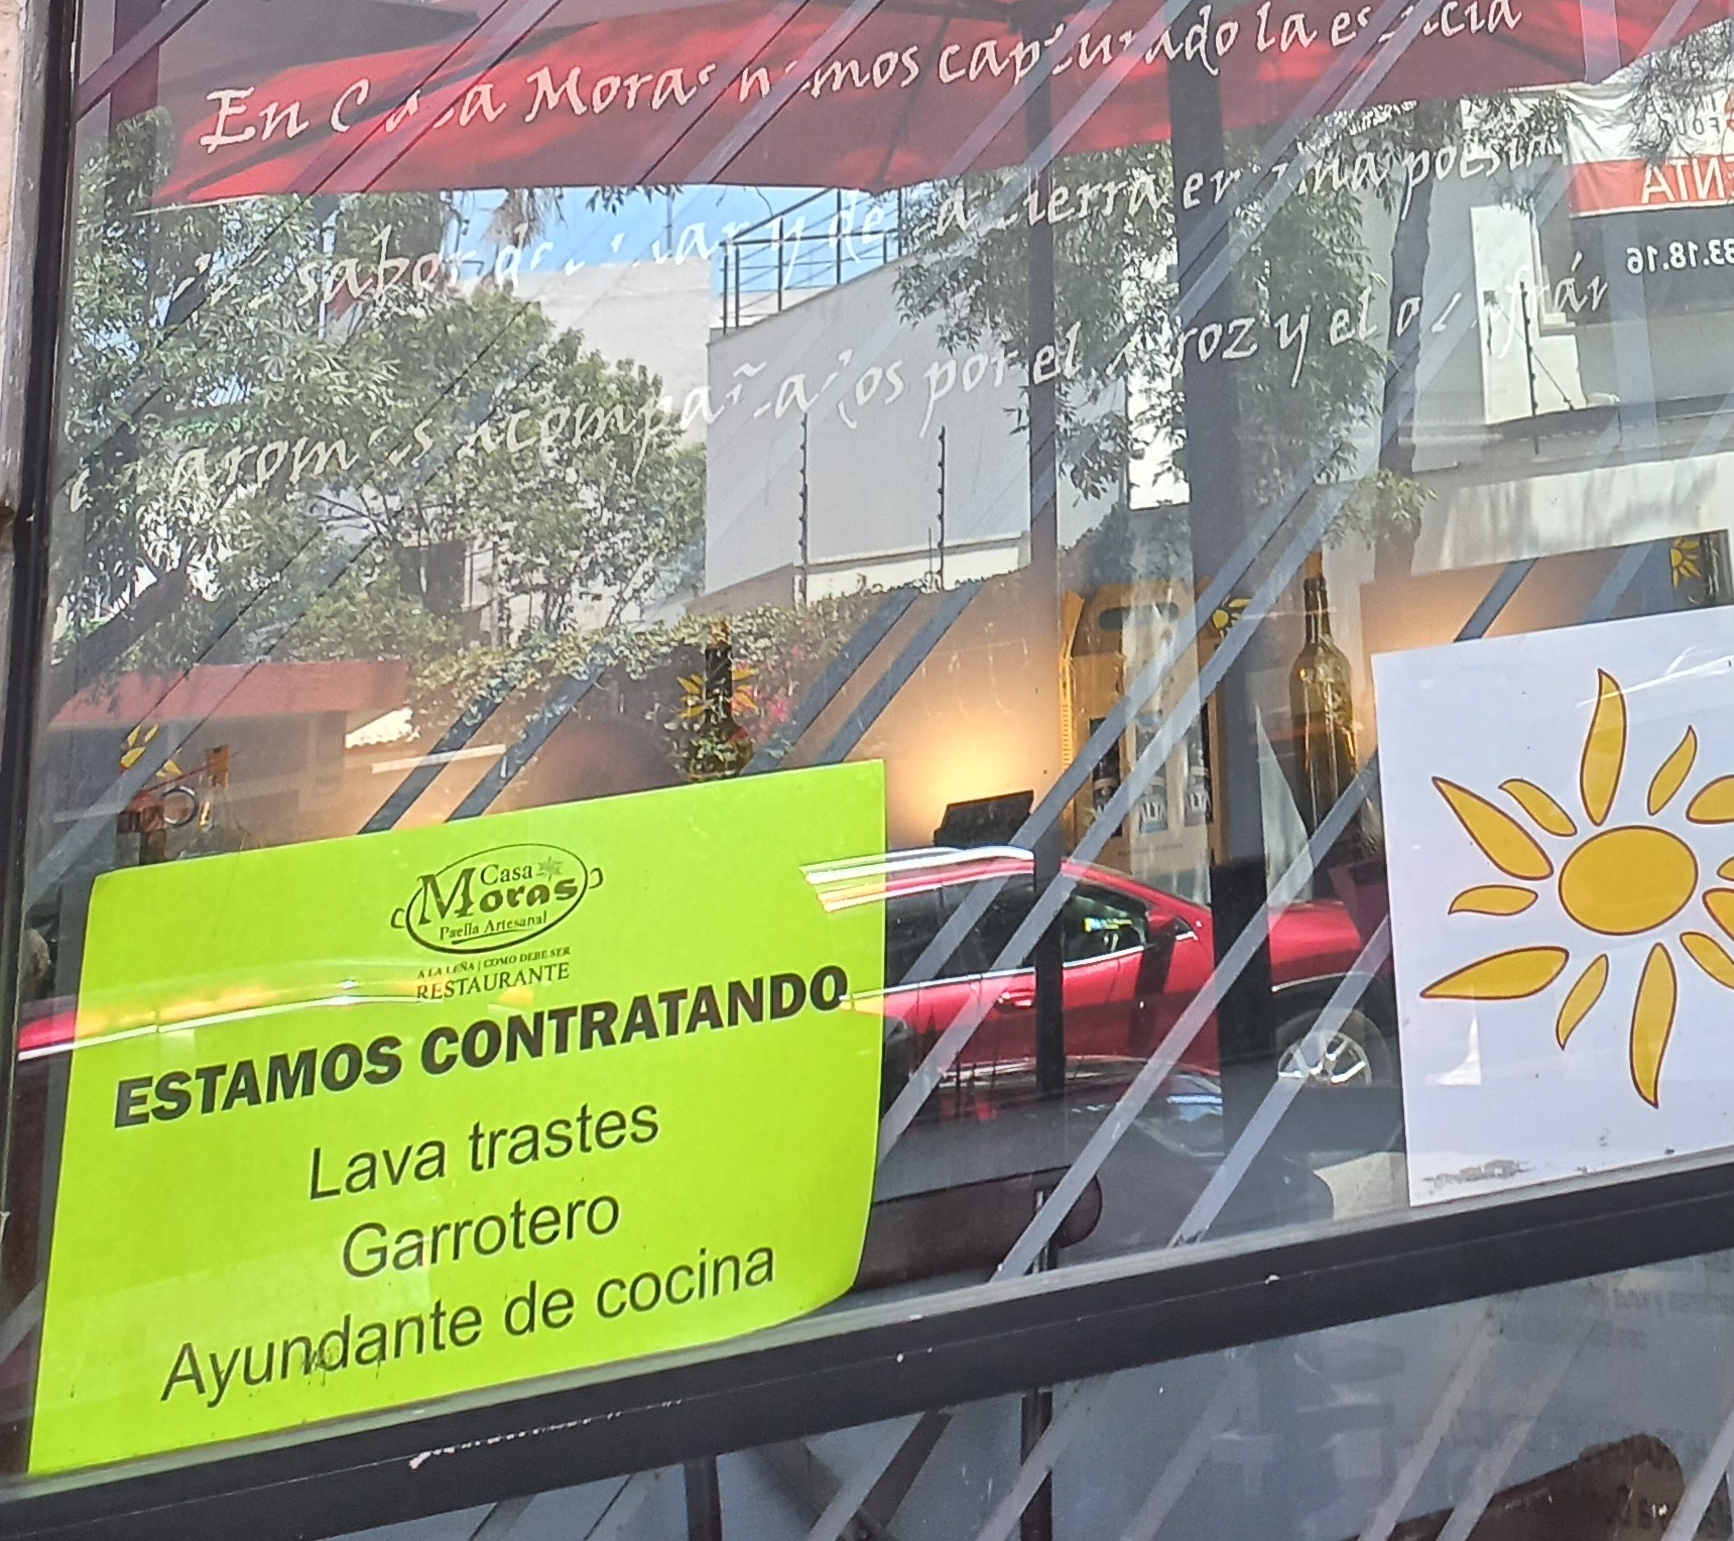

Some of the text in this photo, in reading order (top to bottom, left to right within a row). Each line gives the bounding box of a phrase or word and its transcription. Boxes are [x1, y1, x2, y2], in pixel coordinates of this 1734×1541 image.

[200, 85, 309, 154] En
[331, 78, 507, 134] Caa
[738, 44, 921, 103] hmos
[1256, 0, 1319, 53] la
[998, 169, 1171, 232] ierra
[1273, 151, 1389, 199] na
[920, 347, 1018, 439] por
[1034, 321, 1081, 386] el
[1106, 315, 1259, 375] roz
[1278, 306, 1312, 389] y
[1330, 285, 1375, 347] el
[417, 866, 579, 927] Moras
[480, 863, 533, 886] Casa
[439, 910, 548, 941] Paella Artesanal
[483, 955, 517, 968] COMO
[519, 950, 548, 963] DEBE
[550, 946, 571, 958] SER
[416, 961, 571, 1000] RESTAURANTE
[113, 964, 849, 1128] ESTAMOS CONTRATANDO
[308, 1099, 660, 1201] Lava trastes
[341, 1192, 620, 1278] Garrotero
[161, 1240, 776, 1408] Ayundante de cocina
